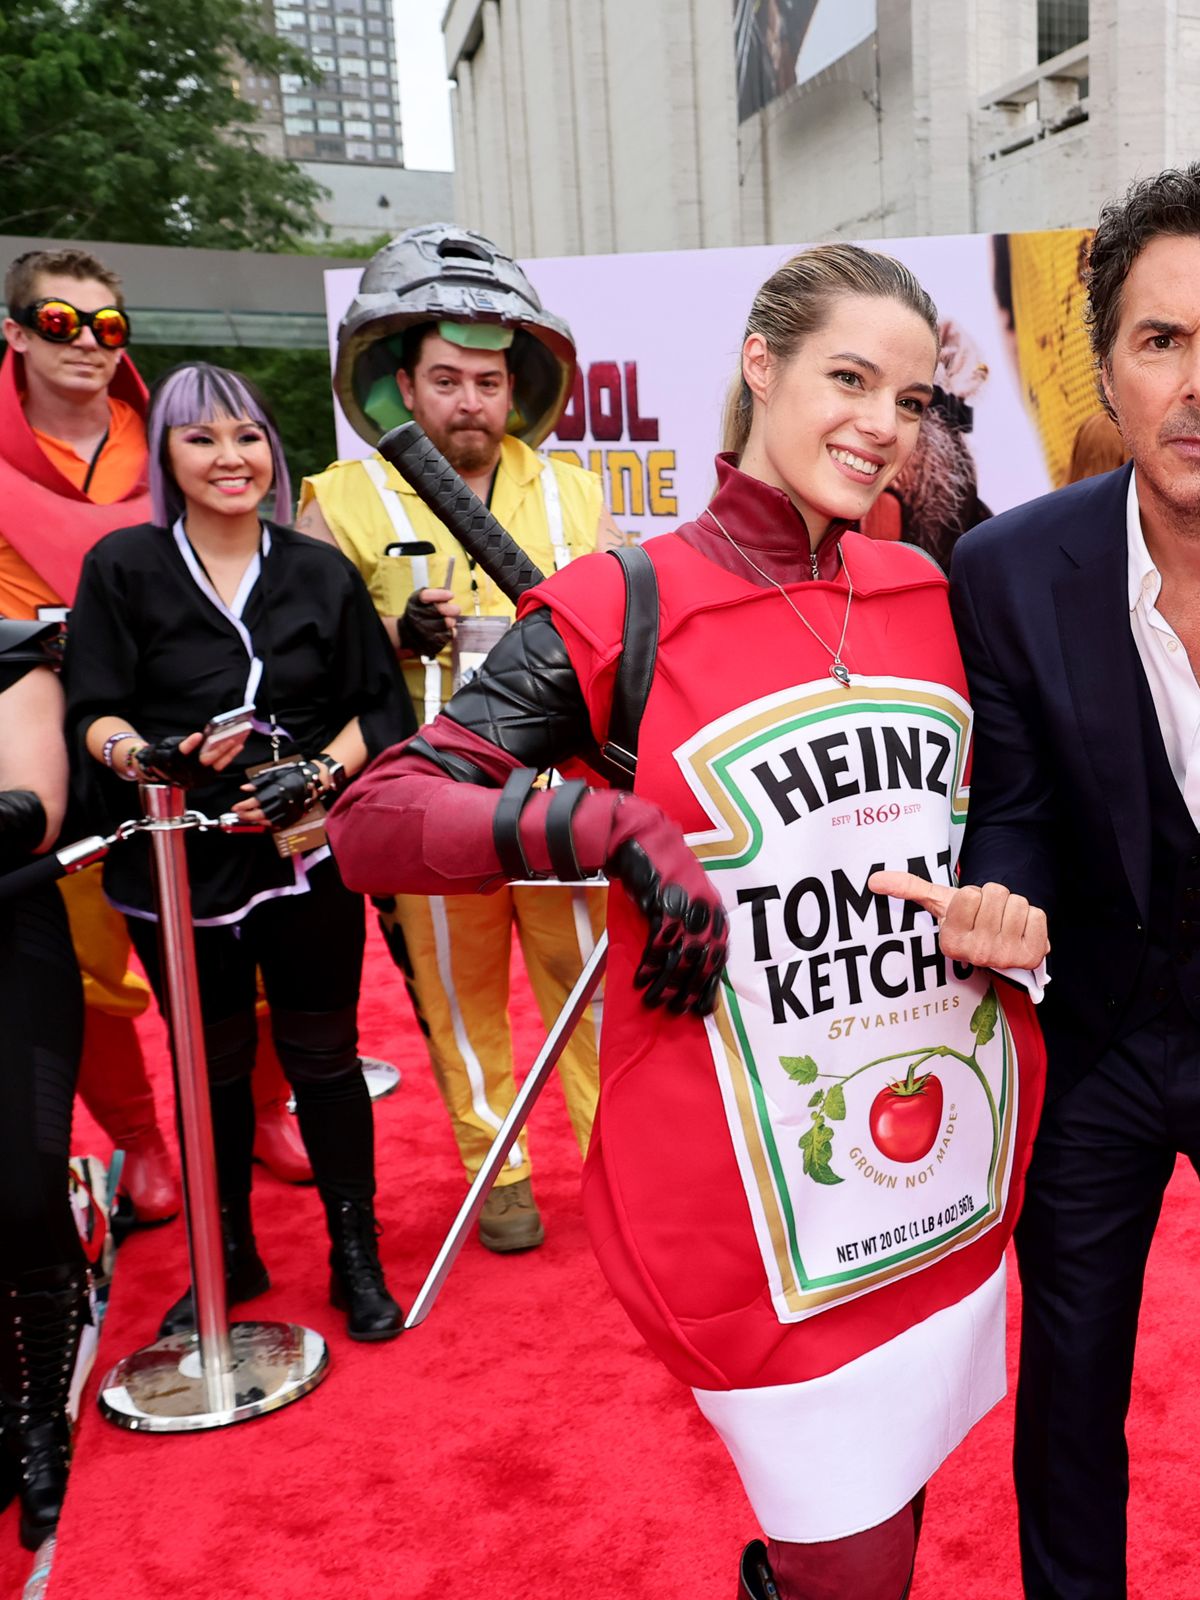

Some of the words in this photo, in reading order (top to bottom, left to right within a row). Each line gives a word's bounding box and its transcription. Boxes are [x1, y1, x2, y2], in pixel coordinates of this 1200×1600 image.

[750, 726, 951, 826] HEINZ
[854, 803, 901, 827] 1869
[827, 1016, 856, 1040] 57
[860, 995, 961, 1031] VARIETIES
[849, 1147, 898, 1189] GROWN
[905, 1164, 935, 1189] NOT
[836, 1242, 859, 1264] NET
[861, 1236, 877, 1256] WT
[880, 1231, 892, 1250] 20
[894, 1225, 907, 1244] OZ
[909, 1220, 920, 1240] (1
[921, 1215, 935, 1234] LB
[937, 1212, 943, 1228] 4
[944, 1203, 959, 1225] OZ)
[958, 1194, 975, 1216] 567g
